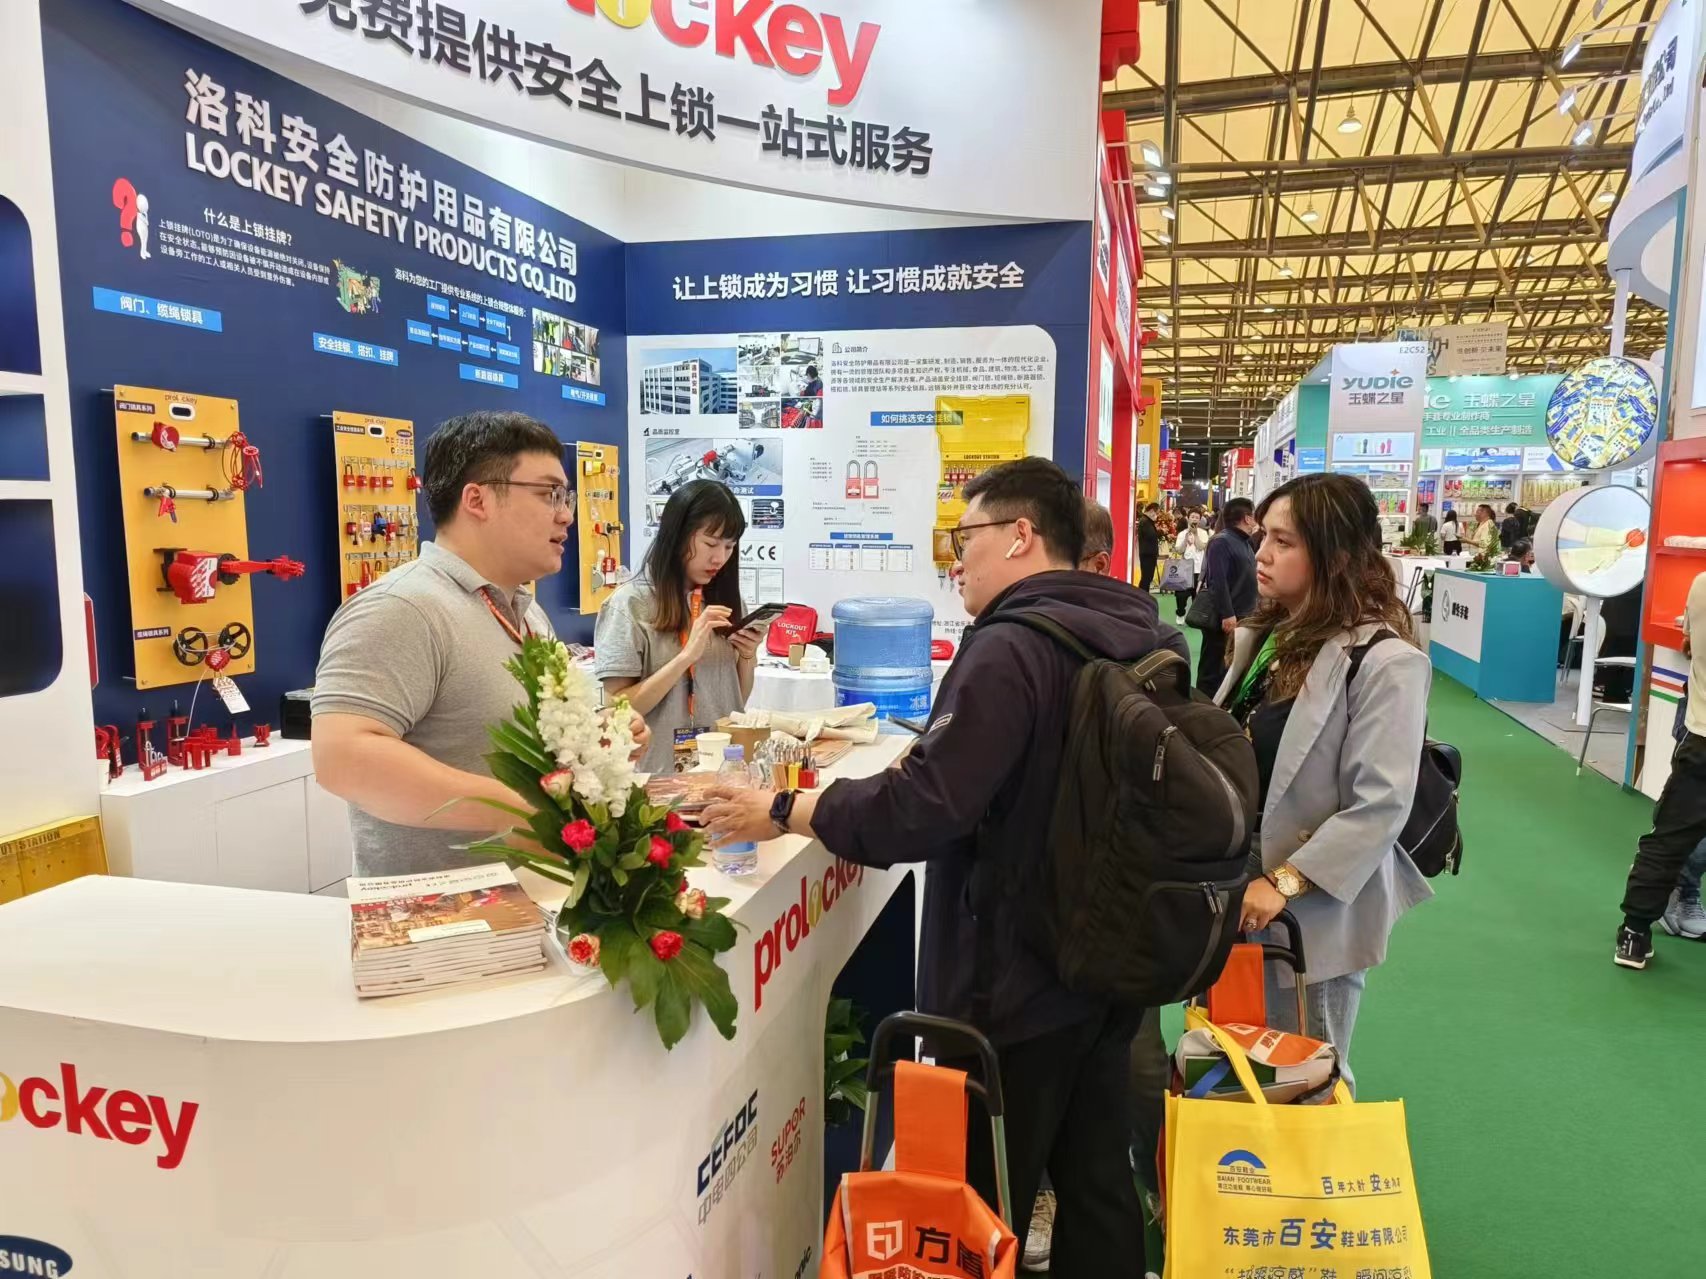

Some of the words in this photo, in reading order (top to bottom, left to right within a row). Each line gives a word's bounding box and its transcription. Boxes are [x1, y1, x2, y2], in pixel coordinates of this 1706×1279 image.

[184, 68, 577, 276] 洛科安全防护用品有限公司
[185, 132, 308, 207] LOCKEY
[314, 181, 408, 244] SAFETY
[413, 220, 518, 283] PRODUCTS
[672, 270, 838, 301] 让上锁成为习惯
[846, 261, 1025, 294] 让习惯成就安全
[120, 295, 203, 325] 阀门、缆绳锁具
[1348, 391, 1404, 406] 玉蝶之星
[1463, 392, 1536, 409] 玉蝶之星
[881, 413, 952, 425] 如何挑选安全挂锁
[1459, 424, 1533, 436] 全品类生产制造
[757, 545, 777, 561] CE
[777, 621, 807, 632] LOCKOUT
[785, 629, 797, 637] KIT
[771, 1096, 806, 1168] SUPOR
[1237, 1176, 1272, 1185] FOOTWEAR
[1223, 1217, 1408, 1250] 东莞市百安鞋业有限公司
